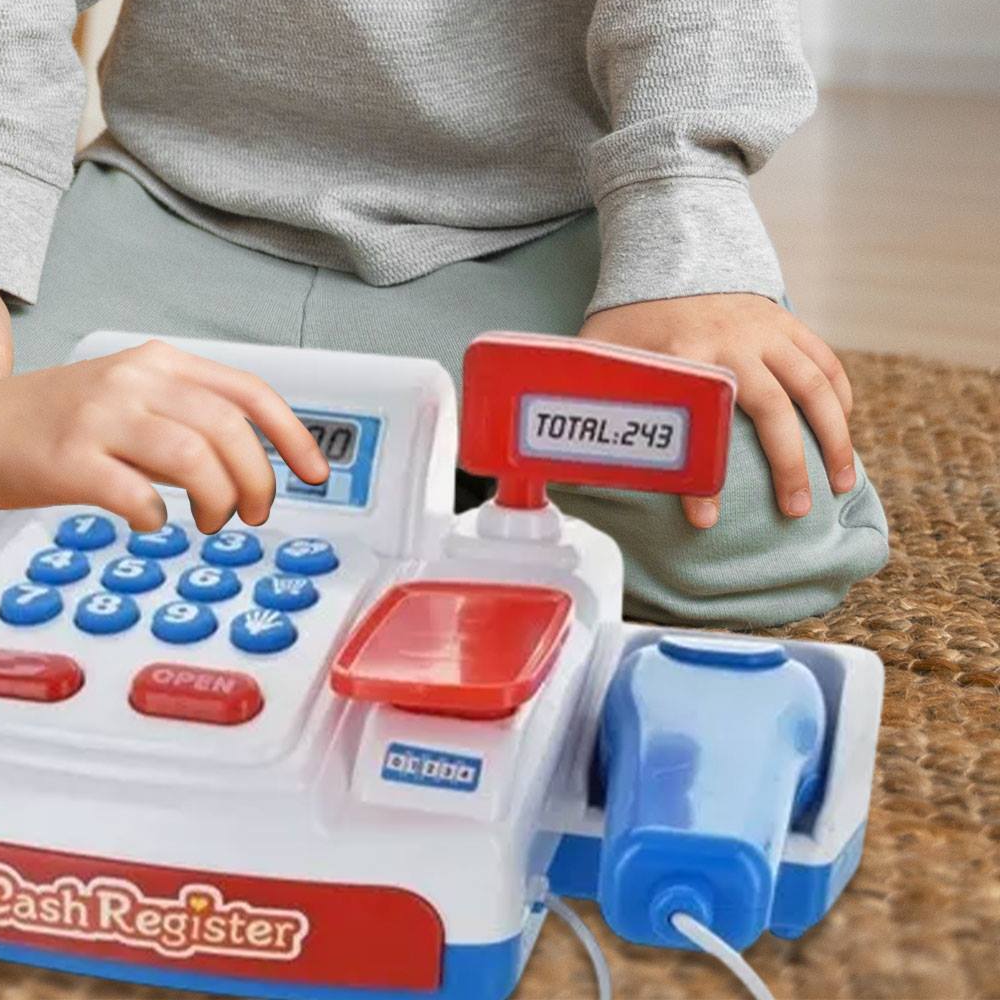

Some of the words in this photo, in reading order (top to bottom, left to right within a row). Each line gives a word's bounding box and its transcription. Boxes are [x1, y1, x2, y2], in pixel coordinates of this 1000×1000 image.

[537, 413, 673, 449] TOTAL:243
[75, 517, 96, 533] 1
[138, 525, 173, 543] 2
[213, 533, 247, 550] 3
[39, 550, 74, 568] 4
[113, 559, 146, 578] 5
[189, 567, 222, 586] 6
[16, 586, 49, 604] 7
[86, 594, 122, 615] 8
[163, 604, 198, 623] 9
[152, 668, 235, 692] OPEN
[98, 890, 297, 947] Register
